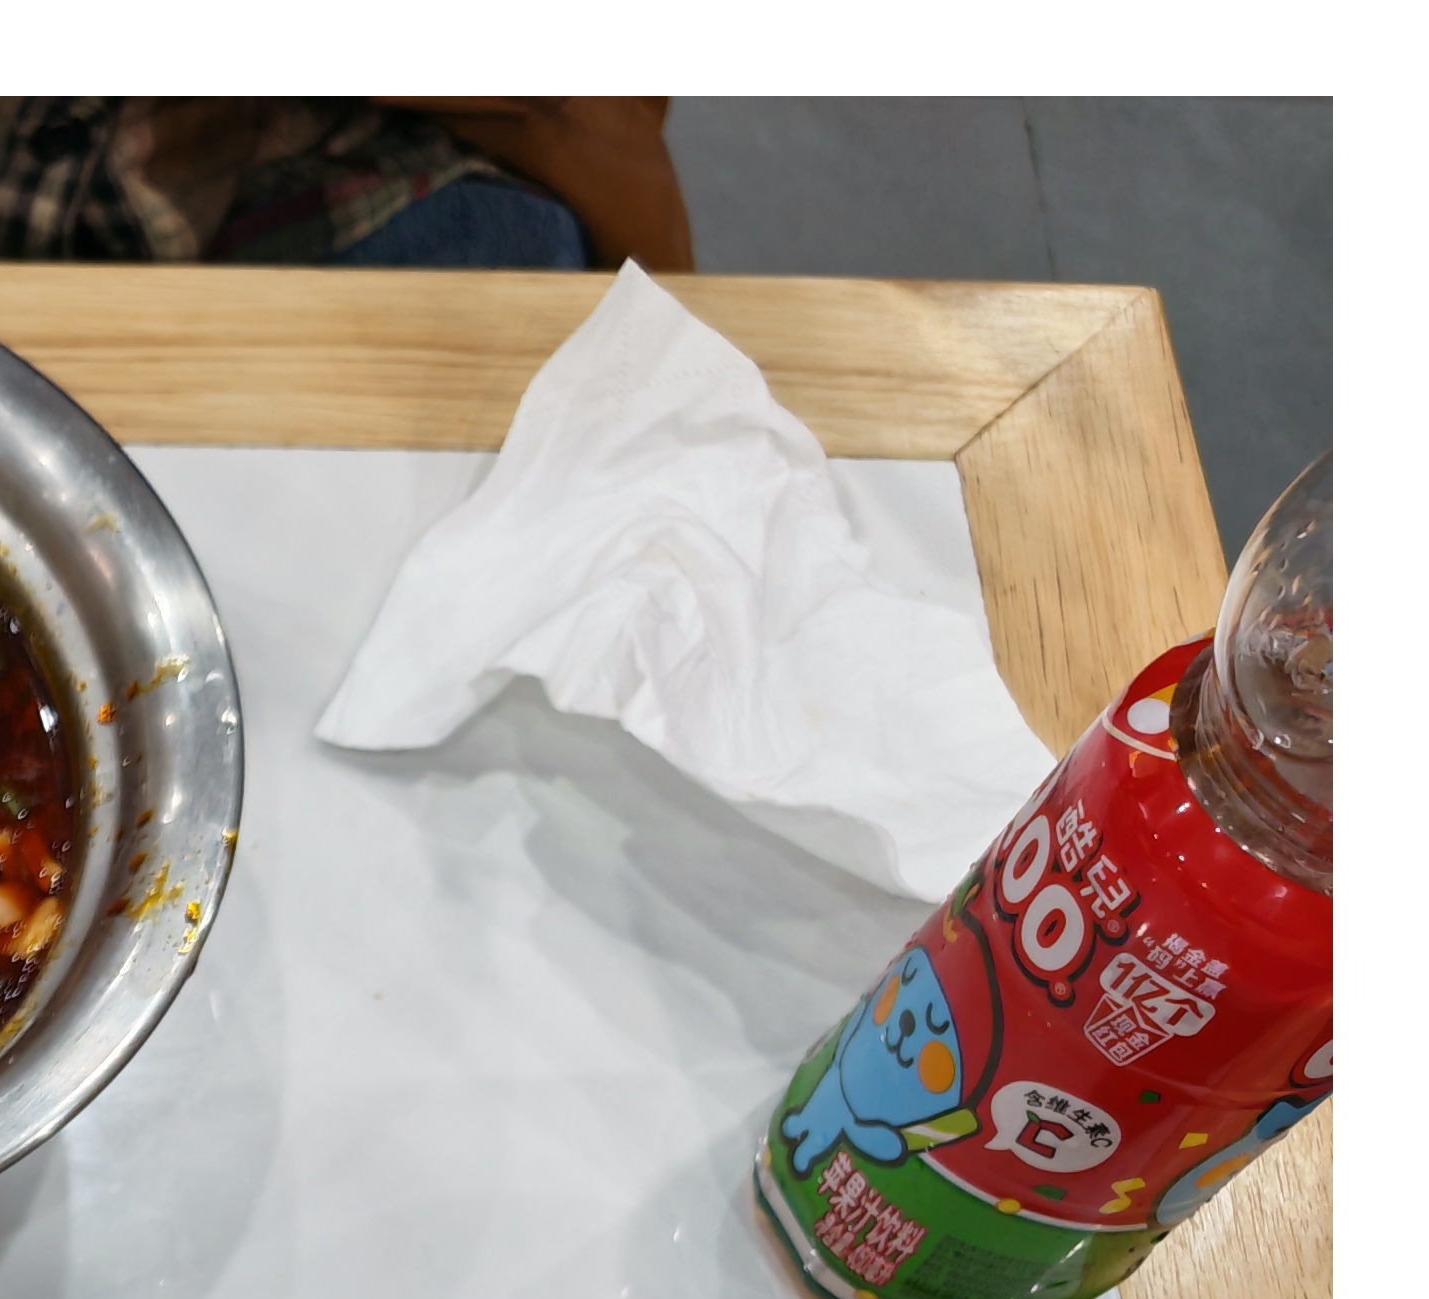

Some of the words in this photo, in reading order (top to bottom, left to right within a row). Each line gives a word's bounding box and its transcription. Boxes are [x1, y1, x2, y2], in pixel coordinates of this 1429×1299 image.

[996, 780, 1085, 971] OO
[1111, 962, 1204, 1027] 1亿个
[1092, 1026, 1134, 1062] 红包
[1024, 1090, 1113, 1149] 含维生素C
[818, 1151, 927, 1264] 苹果汁饮料
